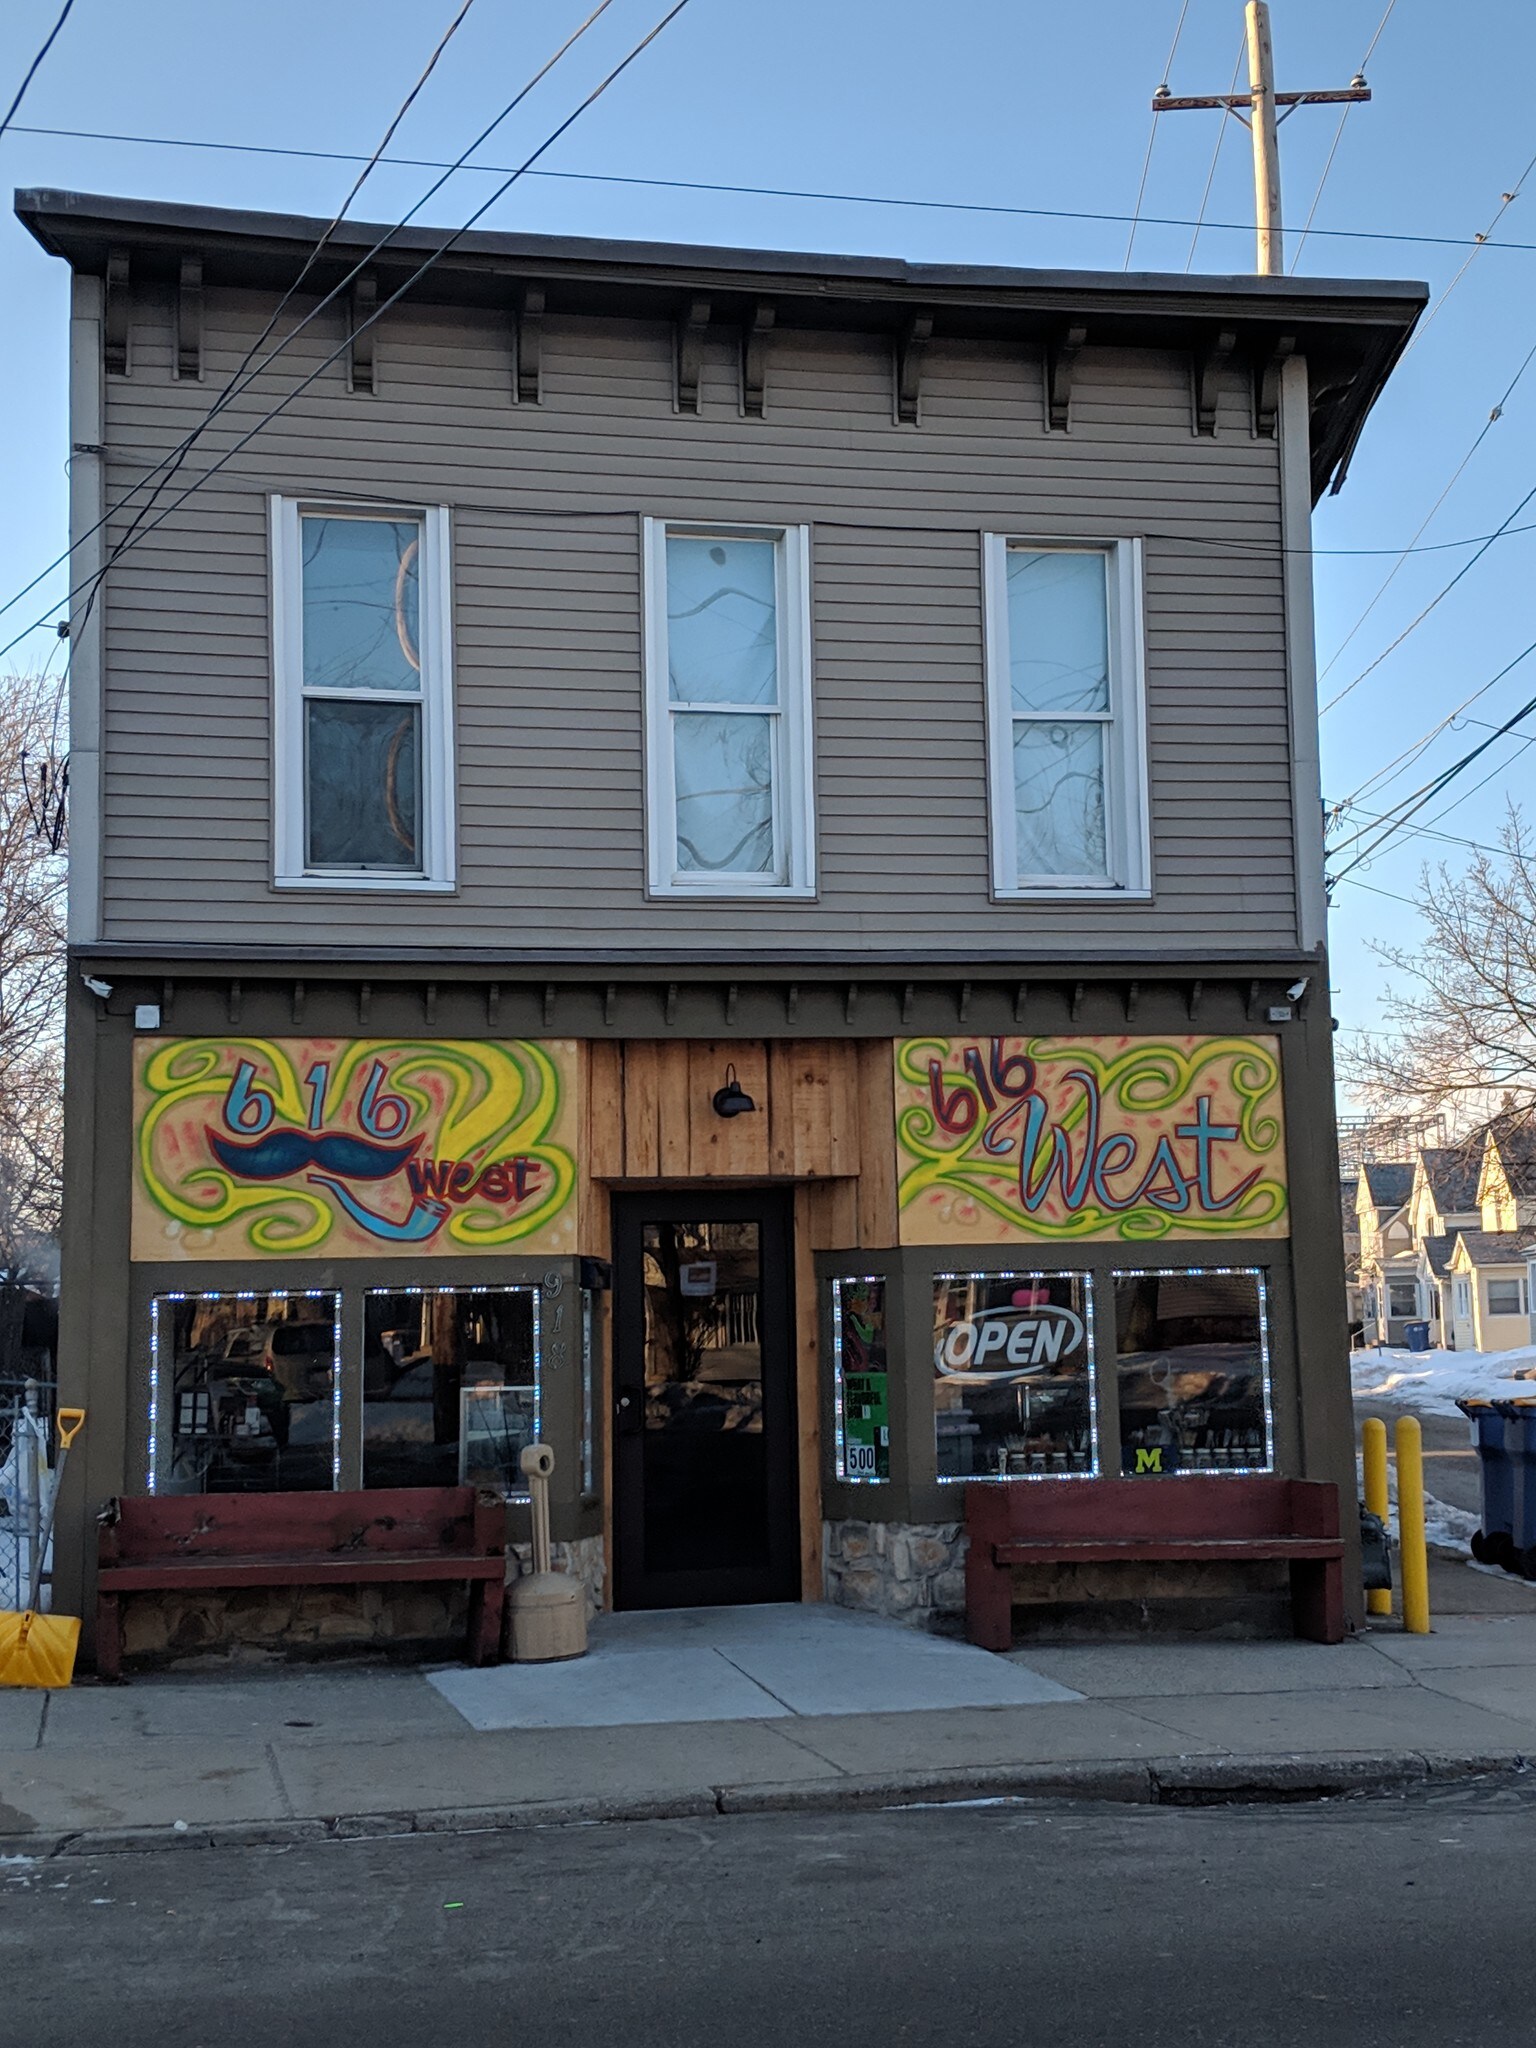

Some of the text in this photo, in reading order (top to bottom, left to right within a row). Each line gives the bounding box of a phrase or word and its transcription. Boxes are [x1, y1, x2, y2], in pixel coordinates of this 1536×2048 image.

[222, 1058, 411, 1140] 616
[929, 1035, 1036, 1134] 616
[983, 1069, 1264, 1212] West
[944, 1320, 1068, 1366] OPEN
[850, 1447, 874, 1470] 500
[1135, 1448, 1162, 1473] M
